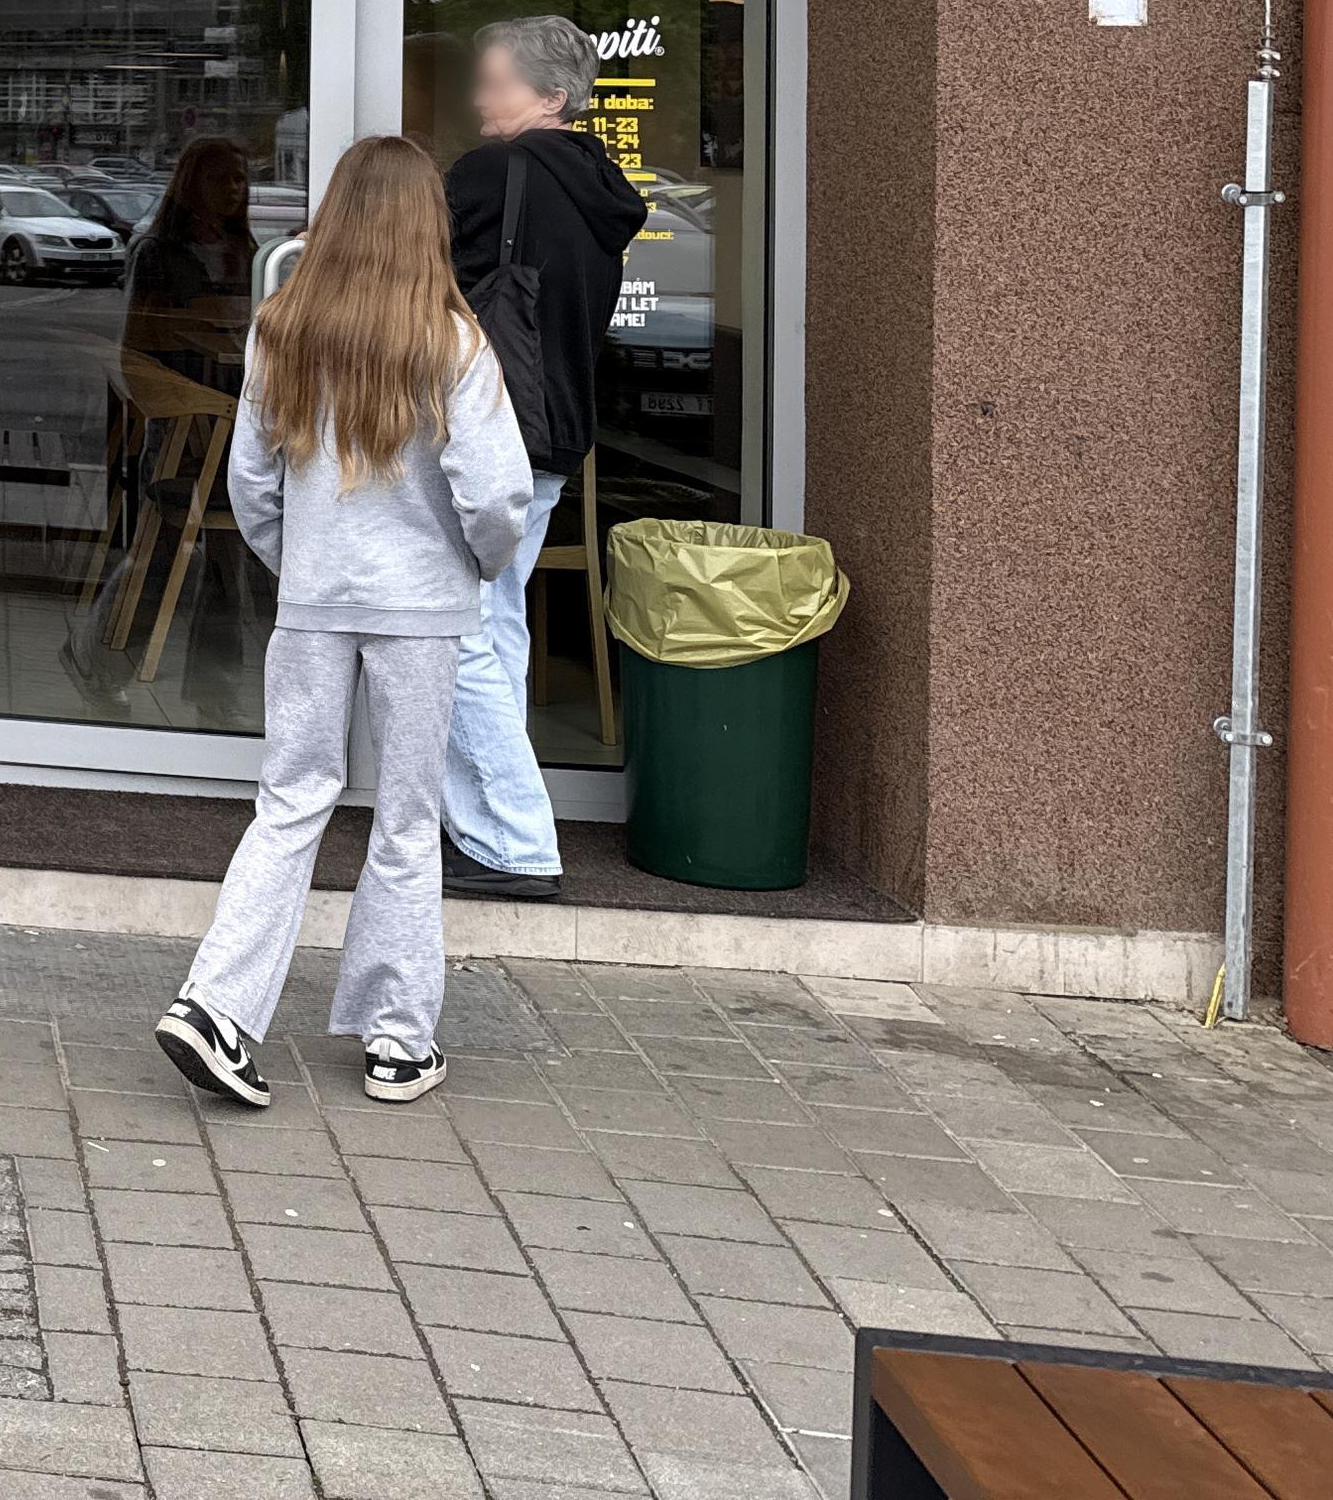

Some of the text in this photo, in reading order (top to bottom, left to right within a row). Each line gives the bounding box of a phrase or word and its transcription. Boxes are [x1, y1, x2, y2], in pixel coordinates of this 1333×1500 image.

[605, 94, 654, 110] doba:
[593, 117, 639, 132] 11-23
[634, 297, 659, 311] LET
[372, 1066, 397, 1081] NIKE
